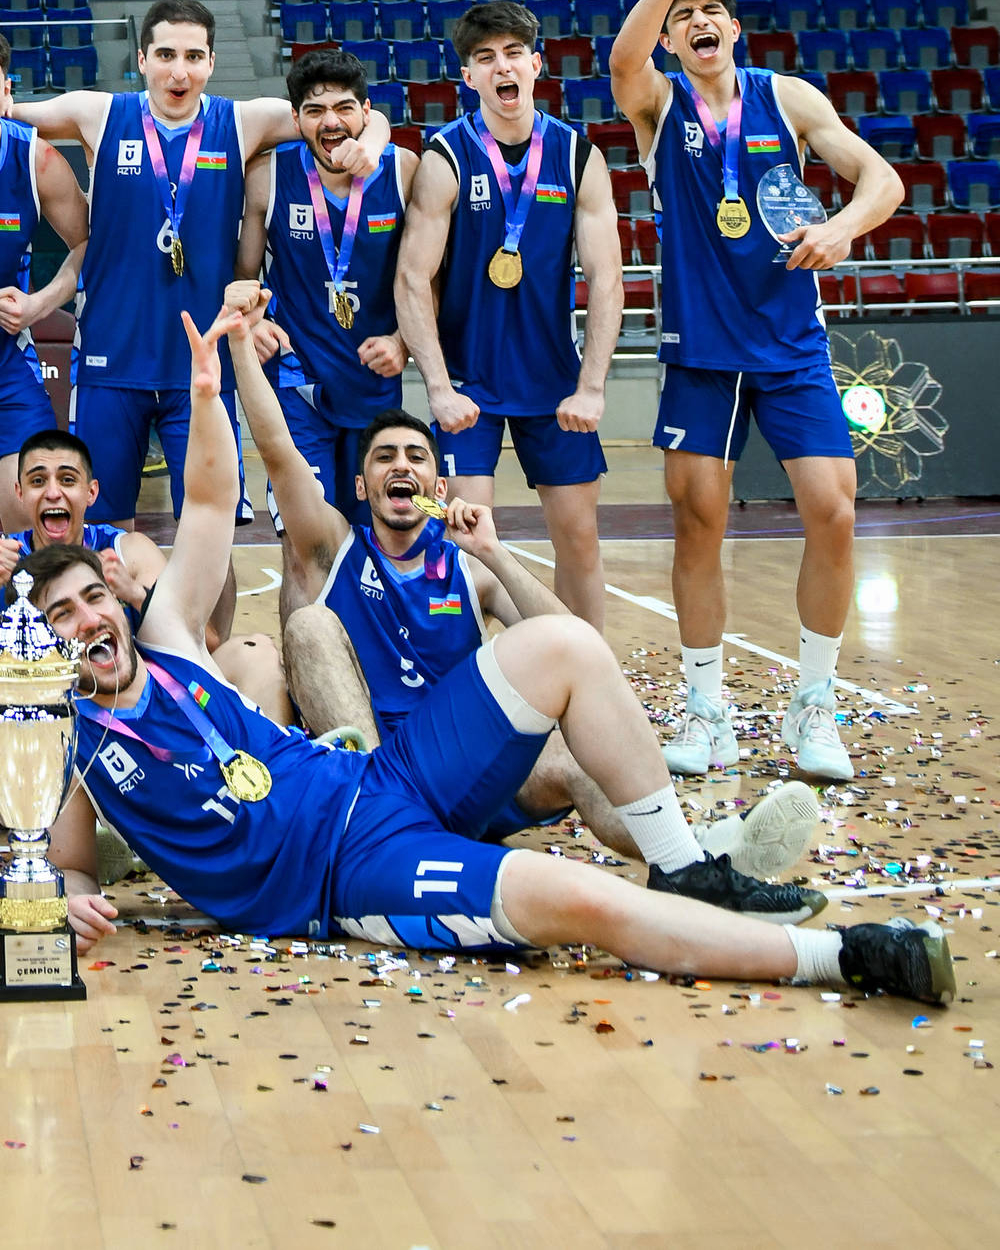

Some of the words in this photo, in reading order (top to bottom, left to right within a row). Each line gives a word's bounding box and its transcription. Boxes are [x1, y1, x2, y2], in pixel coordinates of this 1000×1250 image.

[117, 166, 141, 176] AZTU
[470, 201, 491, 212] AZTU
[157, 218, 175, 254] 6
[289, 230, 314, 240] AZTU
[324, 281, 361, 314] 15
[40, 361, 59, 379] in
[663, 425, 686, 450] 7
[444, 454, 456, 477] 1
[118, 767, 146, 796] AZTU
[413, 860, 464, 899] 11
[17, 966, 60, 977] ÇEMPİON
